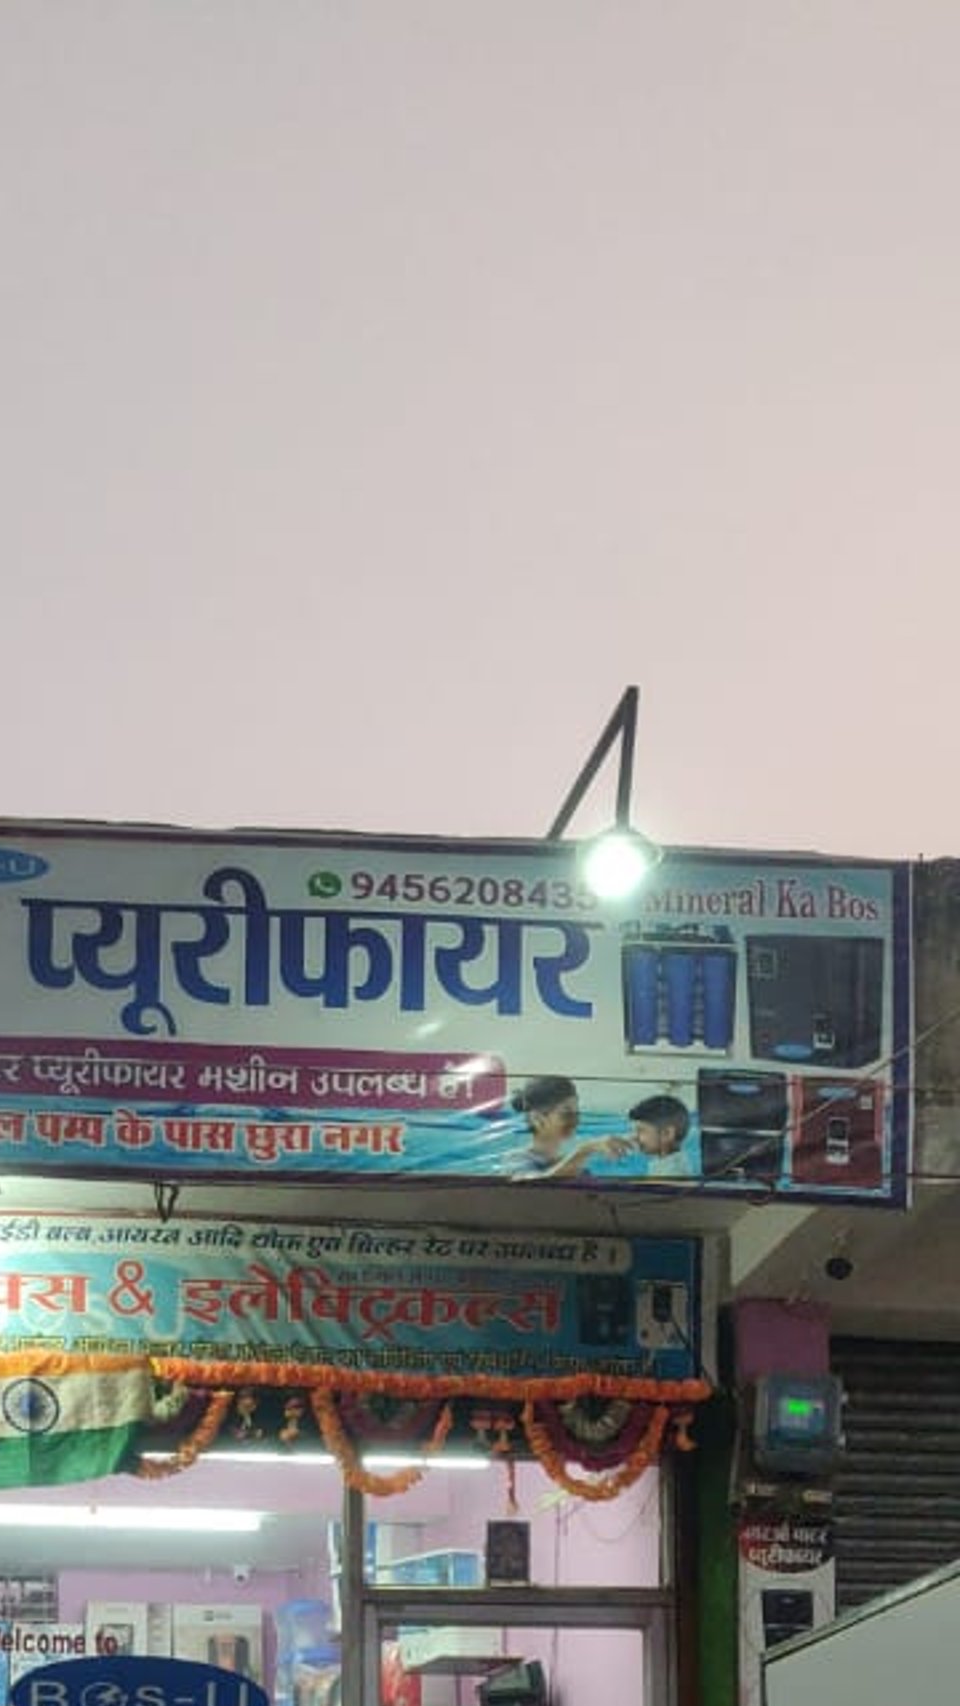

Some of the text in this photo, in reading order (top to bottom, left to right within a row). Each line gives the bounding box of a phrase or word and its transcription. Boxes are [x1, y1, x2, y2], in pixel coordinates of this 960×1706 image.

[776, 879, 817, 919] Ka
[827, 885, 879, 920] Bos
[21, 866, 605, 1037] प्यूरीफायर
[30, 1047, 187, 1096] प्यूरीफायर
[197, 1053, 300, 1094] मशीन
[308, 1067, 428, 1099] उपलब्ध
[34, 1111, 107, 1147] पम्प
[114, 1107, 154, 1148] के
[161, 1117, 237, 1153] पास
[319, 1122, 407, 1154] नगर
[108, 1259, 155, 1317] &
[96, 1630, 119, 1655] to
